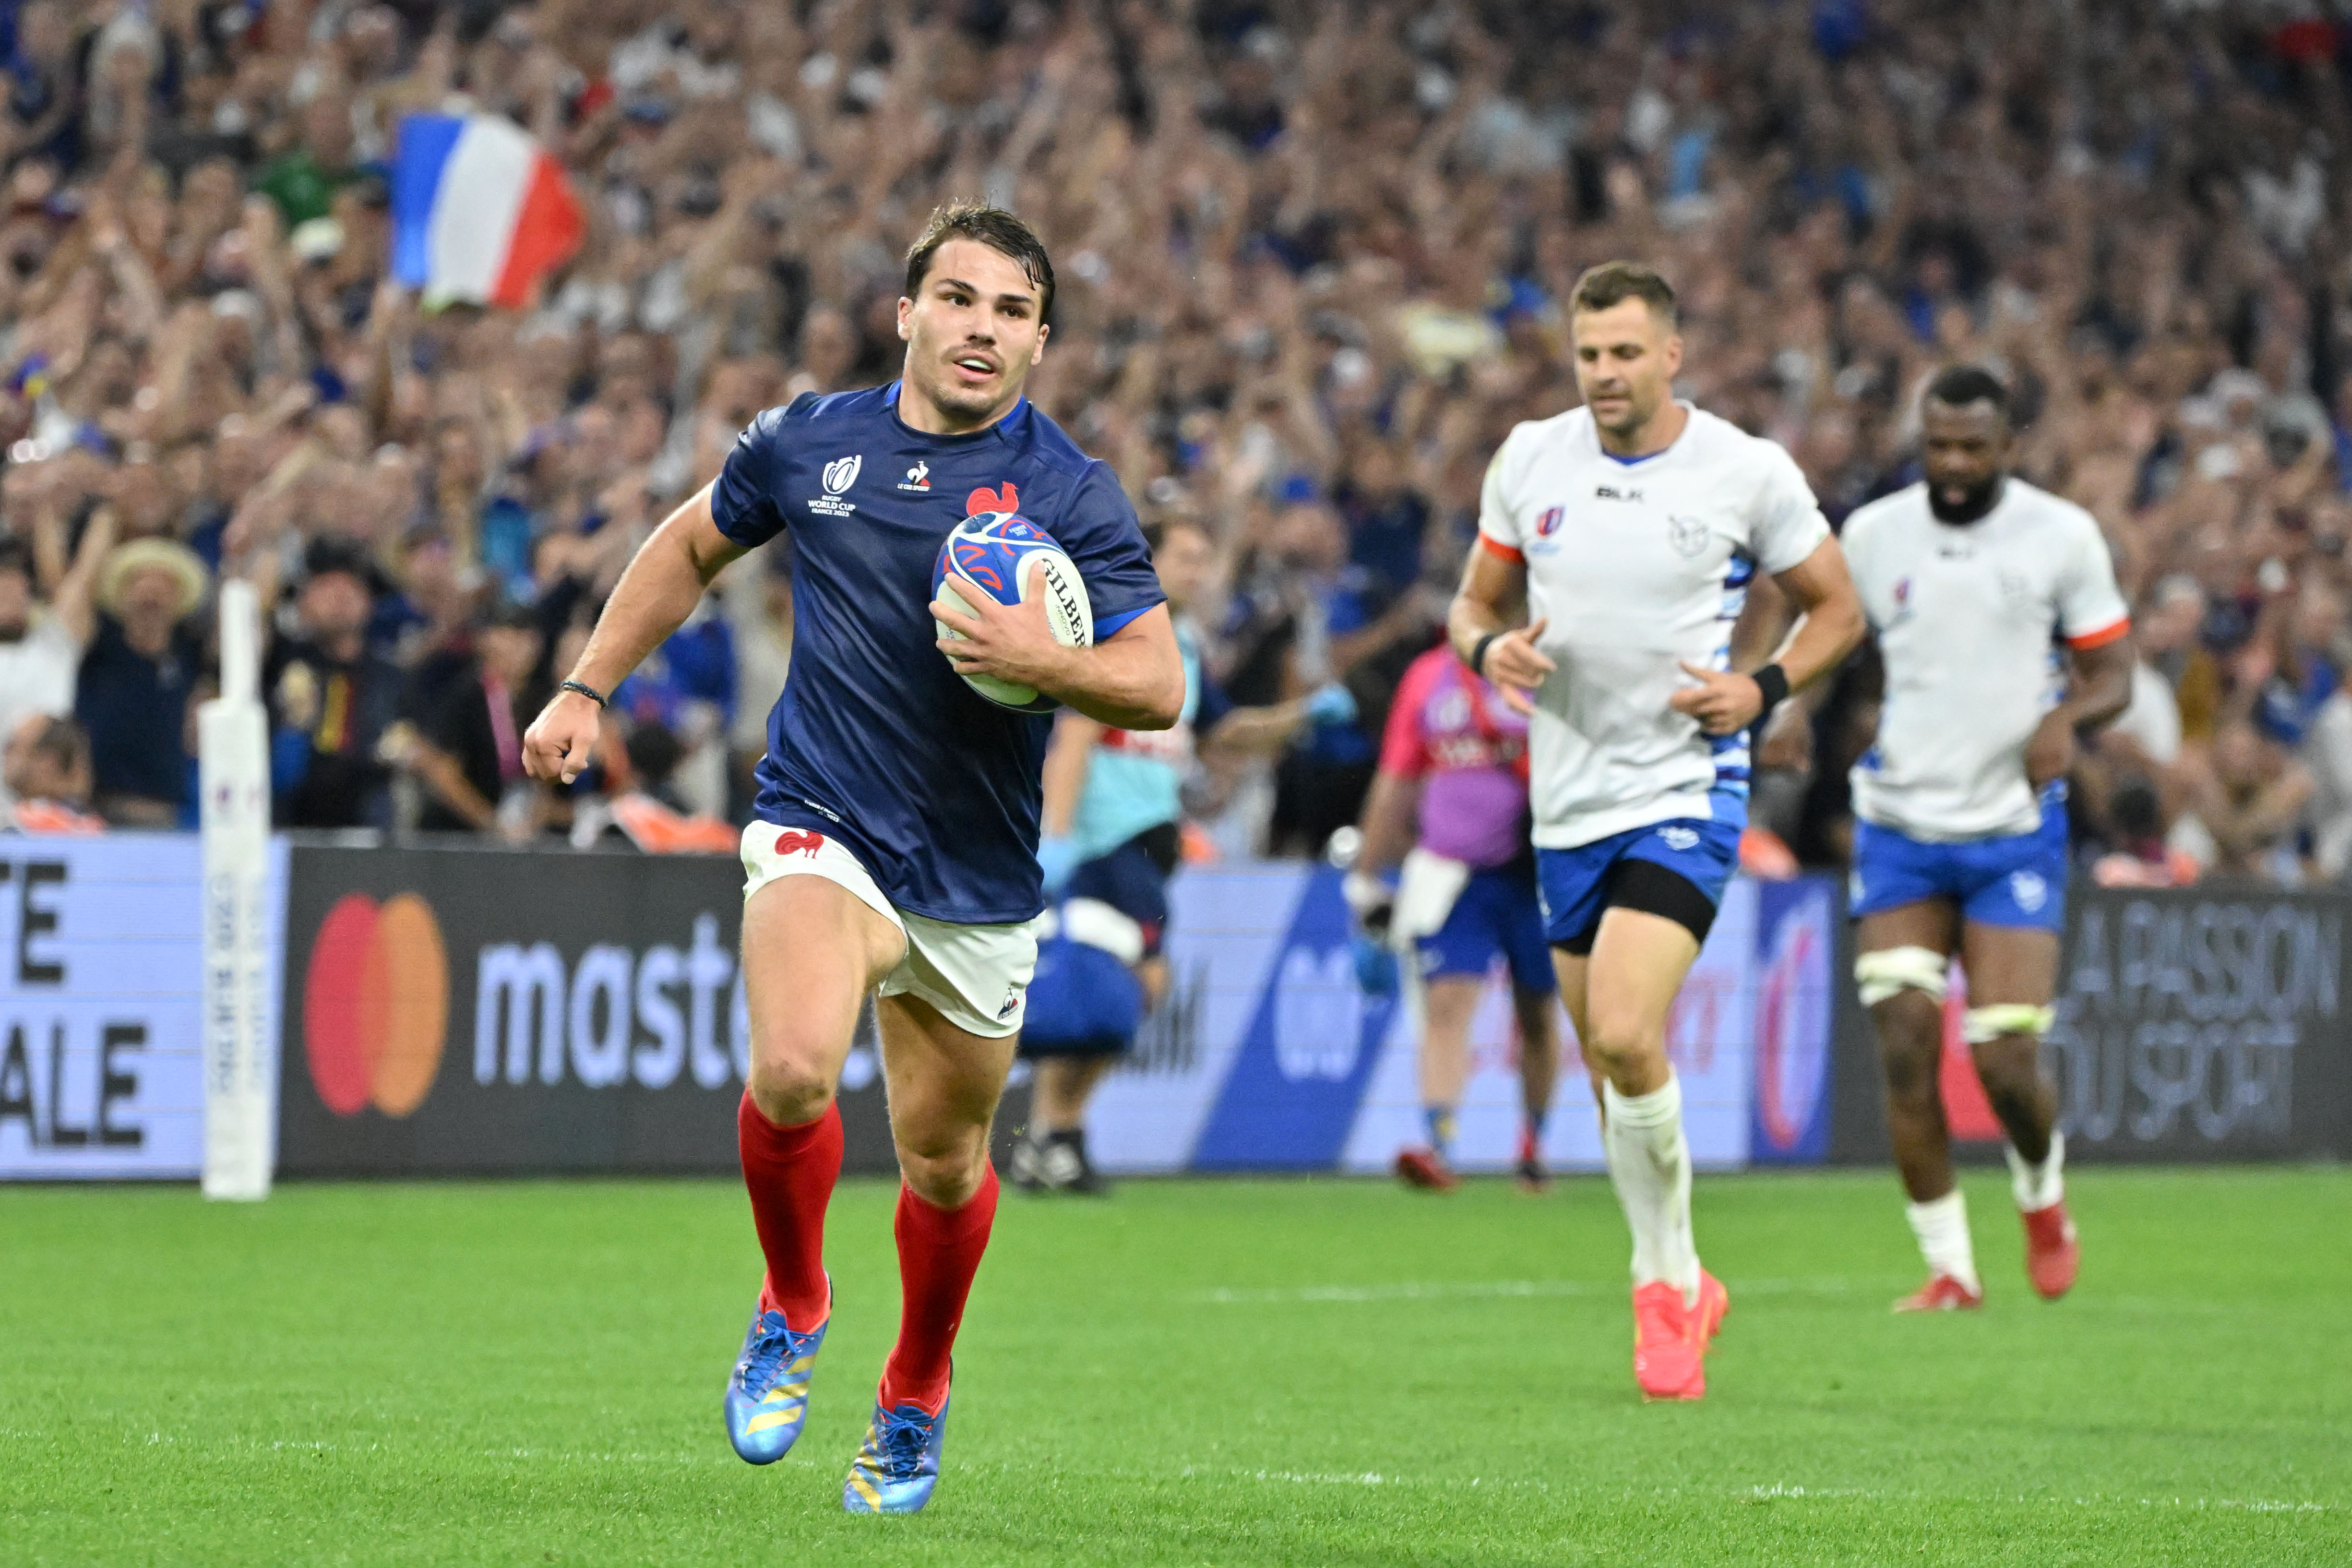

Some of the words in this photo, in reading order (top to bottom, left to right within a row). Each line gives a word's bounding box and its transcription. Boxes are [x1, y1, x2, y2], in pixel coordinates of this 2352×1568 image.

[808, 500, 838, 509] WORLD
[838, 503, 856, 511] CUP
[1042, 557, 1086, 647] GILBER
